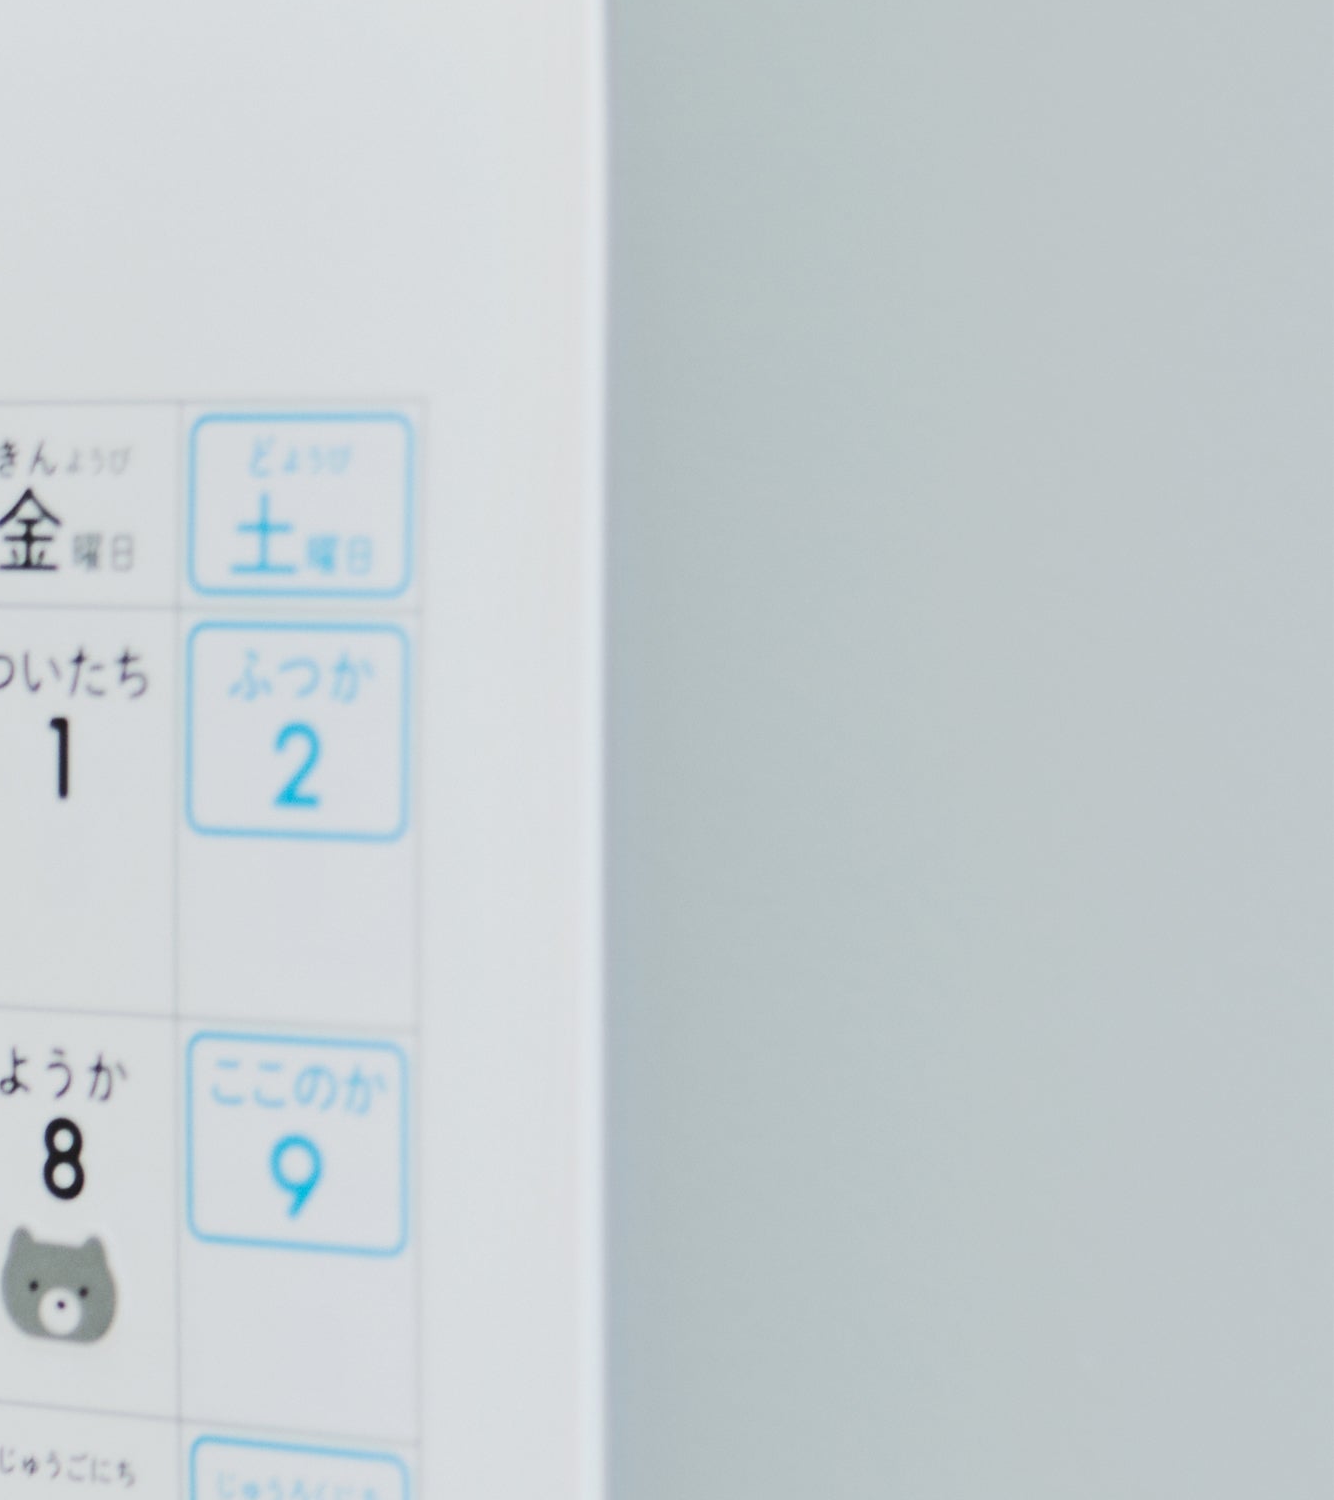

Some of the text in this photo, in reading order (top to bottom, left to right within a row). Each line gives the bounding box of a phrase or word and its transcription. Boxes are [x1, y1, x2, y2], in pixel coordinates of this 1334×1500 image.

[229, 492, 372, 577] 土曜日
[227, 648, 375, 705] ふつか
[49, 716, 70, 800] 1
[273, 721, 322, 809] 2
[210, 1058, 386, 1116] ここのか
[42, 1116, 86, 1201] 8
[269, 1133, 324, 1219] 9
[0, 1447, 136, 1488] じゅうごにち
